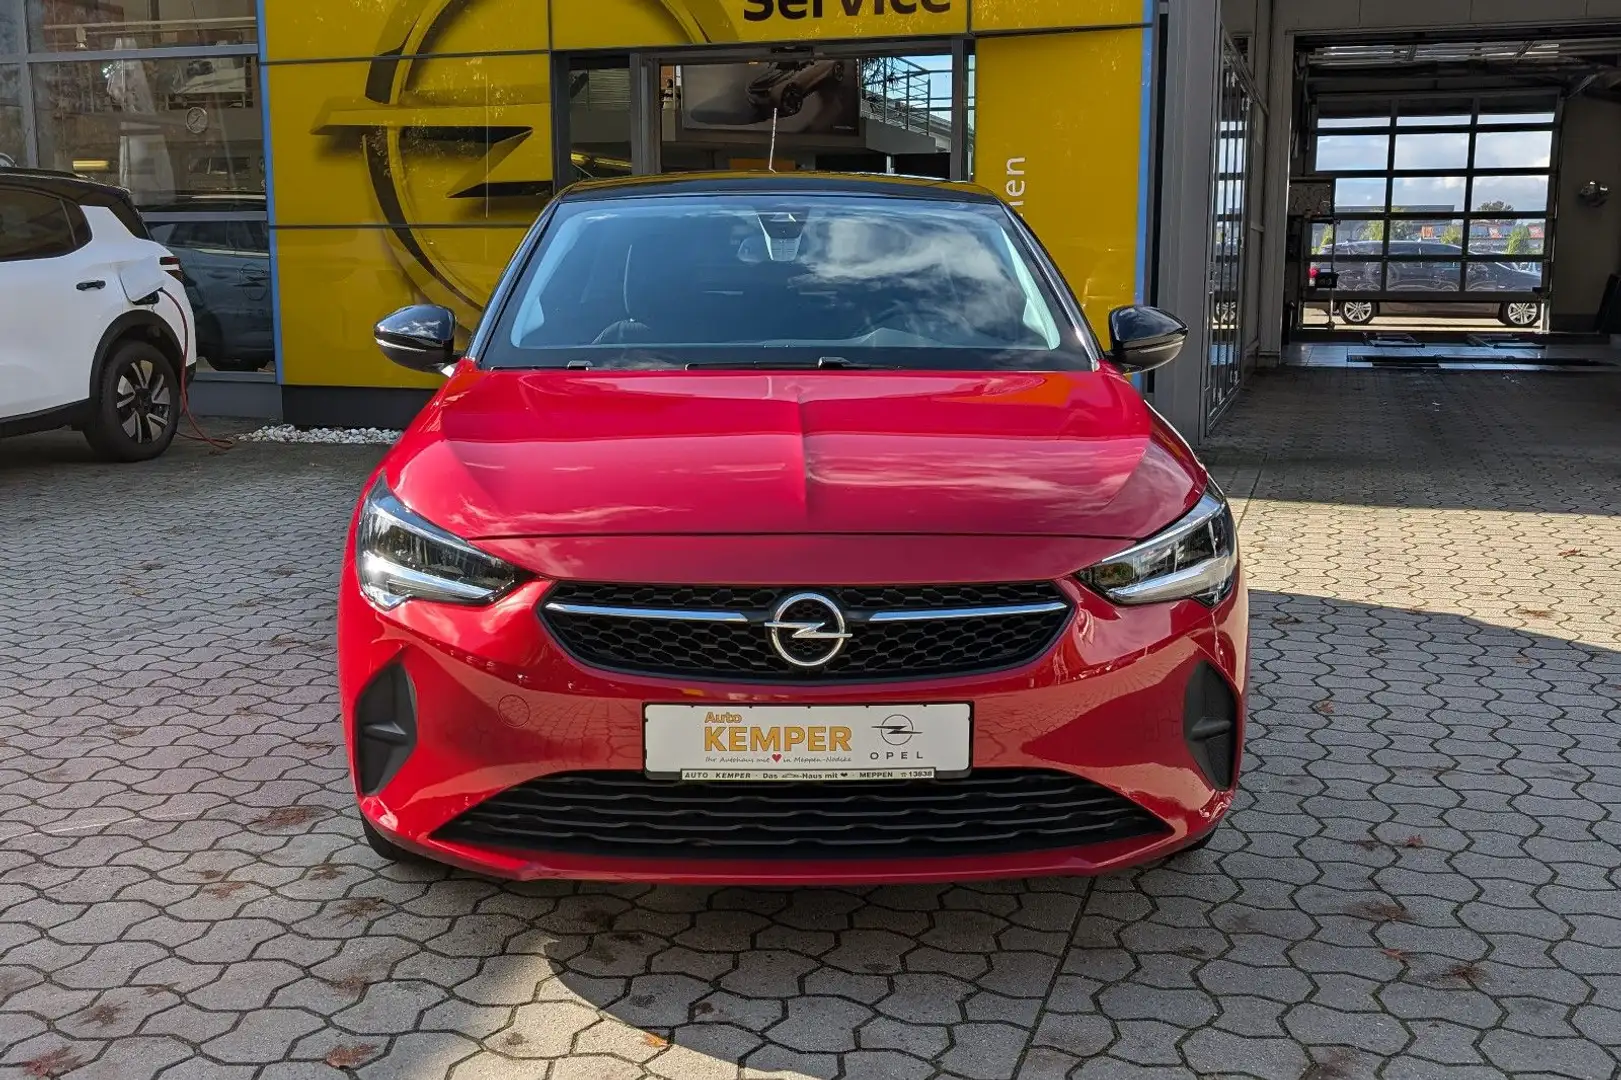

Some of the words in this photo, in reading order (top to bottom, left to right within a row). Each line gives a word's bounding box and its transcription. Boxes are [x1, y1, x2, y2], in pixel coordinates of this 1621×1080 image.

[704, 711, 743, 724] Auto
[704, 726, 853, 752] KEMPER
[719, 756, 754, 764] Autohaus
[869, 751, 924, 760] OPEL
